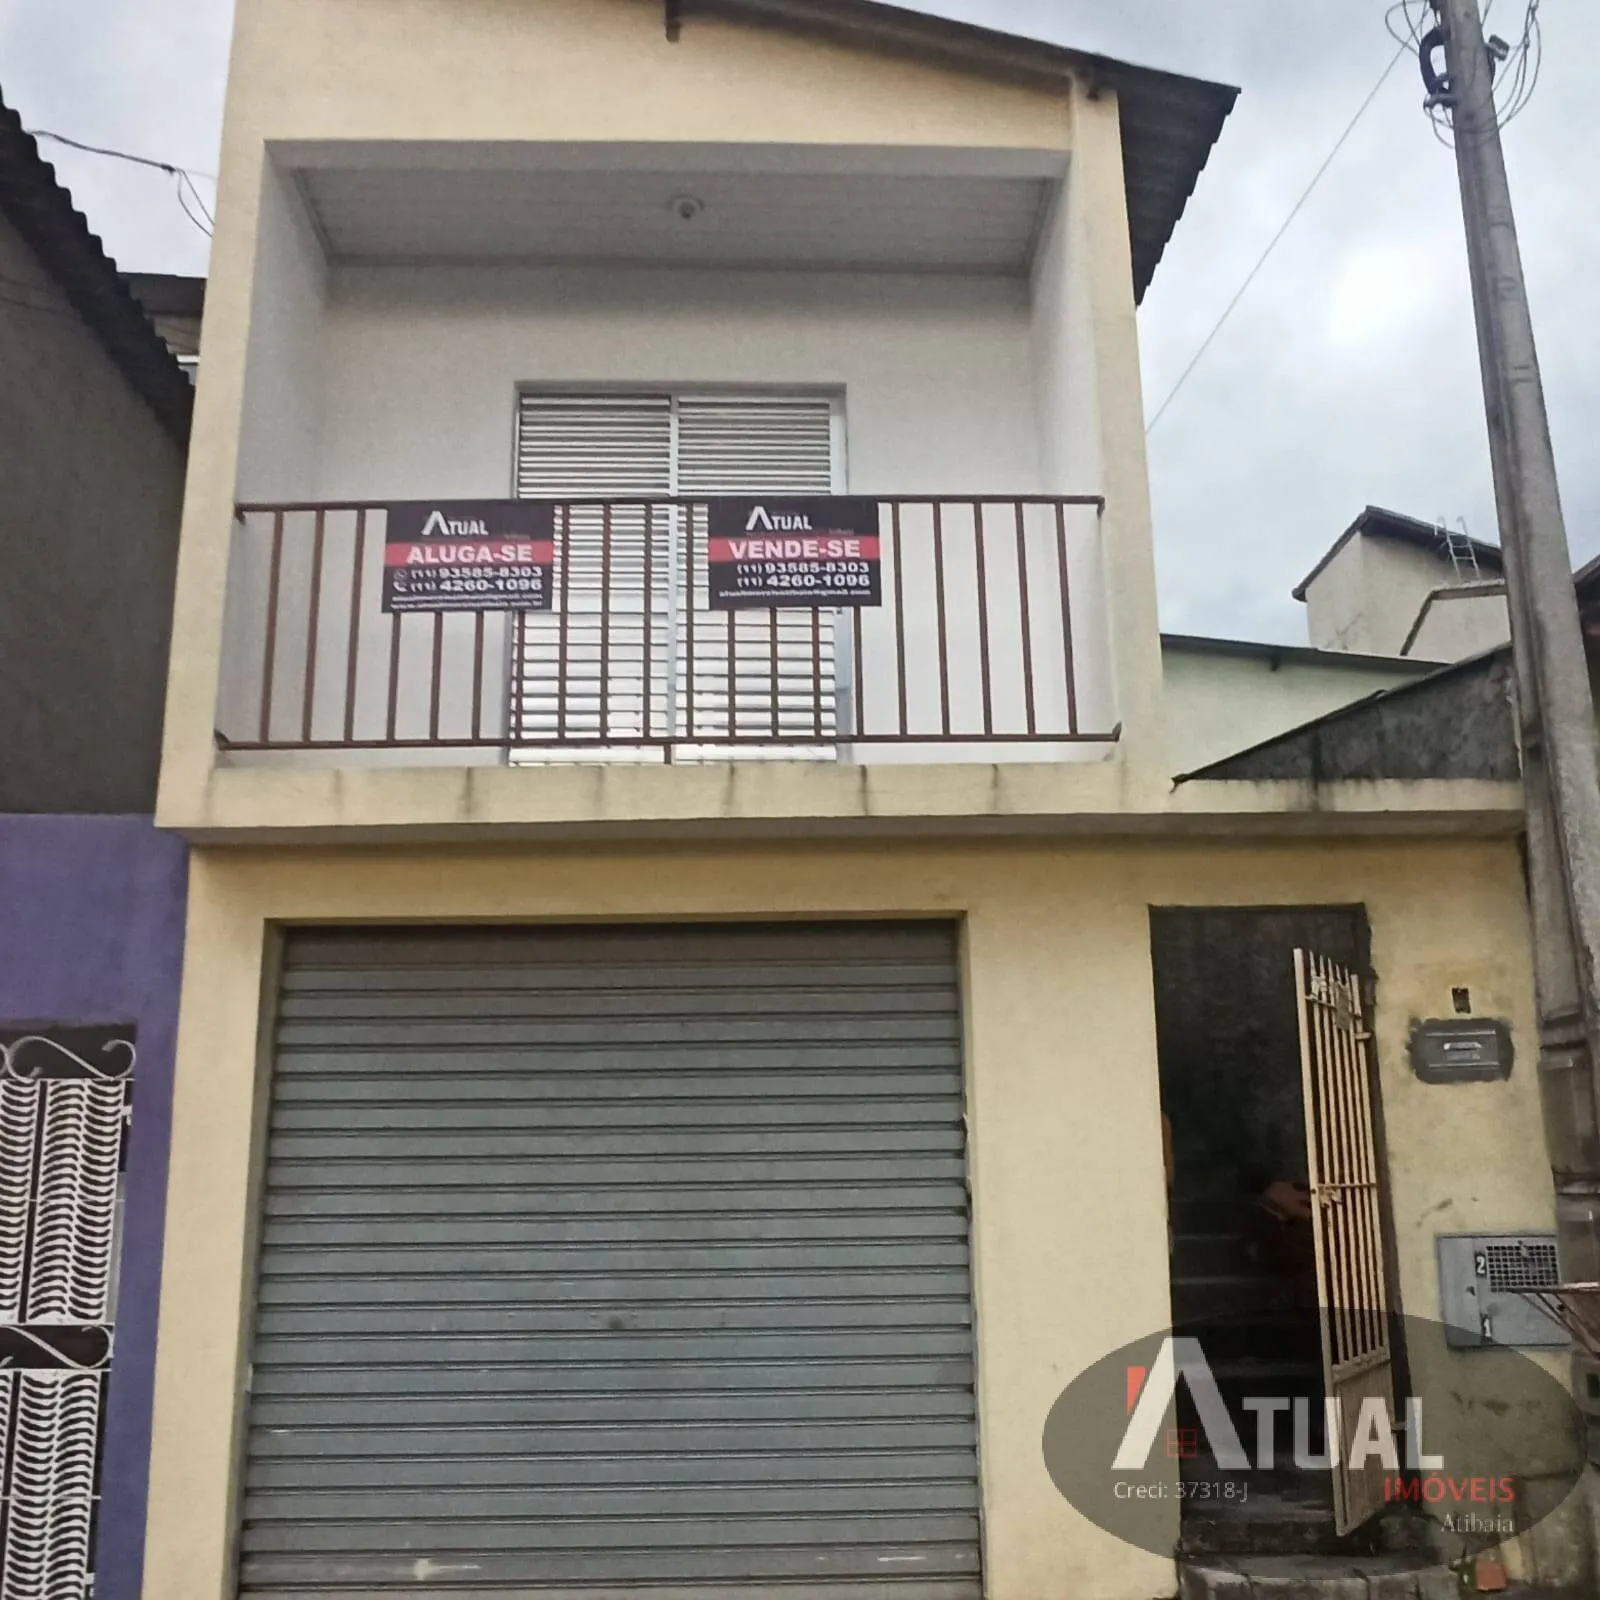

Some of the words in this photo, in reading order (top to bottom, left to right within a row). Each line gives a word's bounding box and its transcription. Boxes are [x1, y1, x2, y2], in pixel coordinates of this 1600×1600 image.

[421, 510, 489, 536] ATUAL
[745, 505, 813, 531] ATUAL
[406, 544, 533, 565] ALUGA-SE
[728, 539, 861, 560] VENDE-SE
[1476, 1255, 1486, 1274] 2
